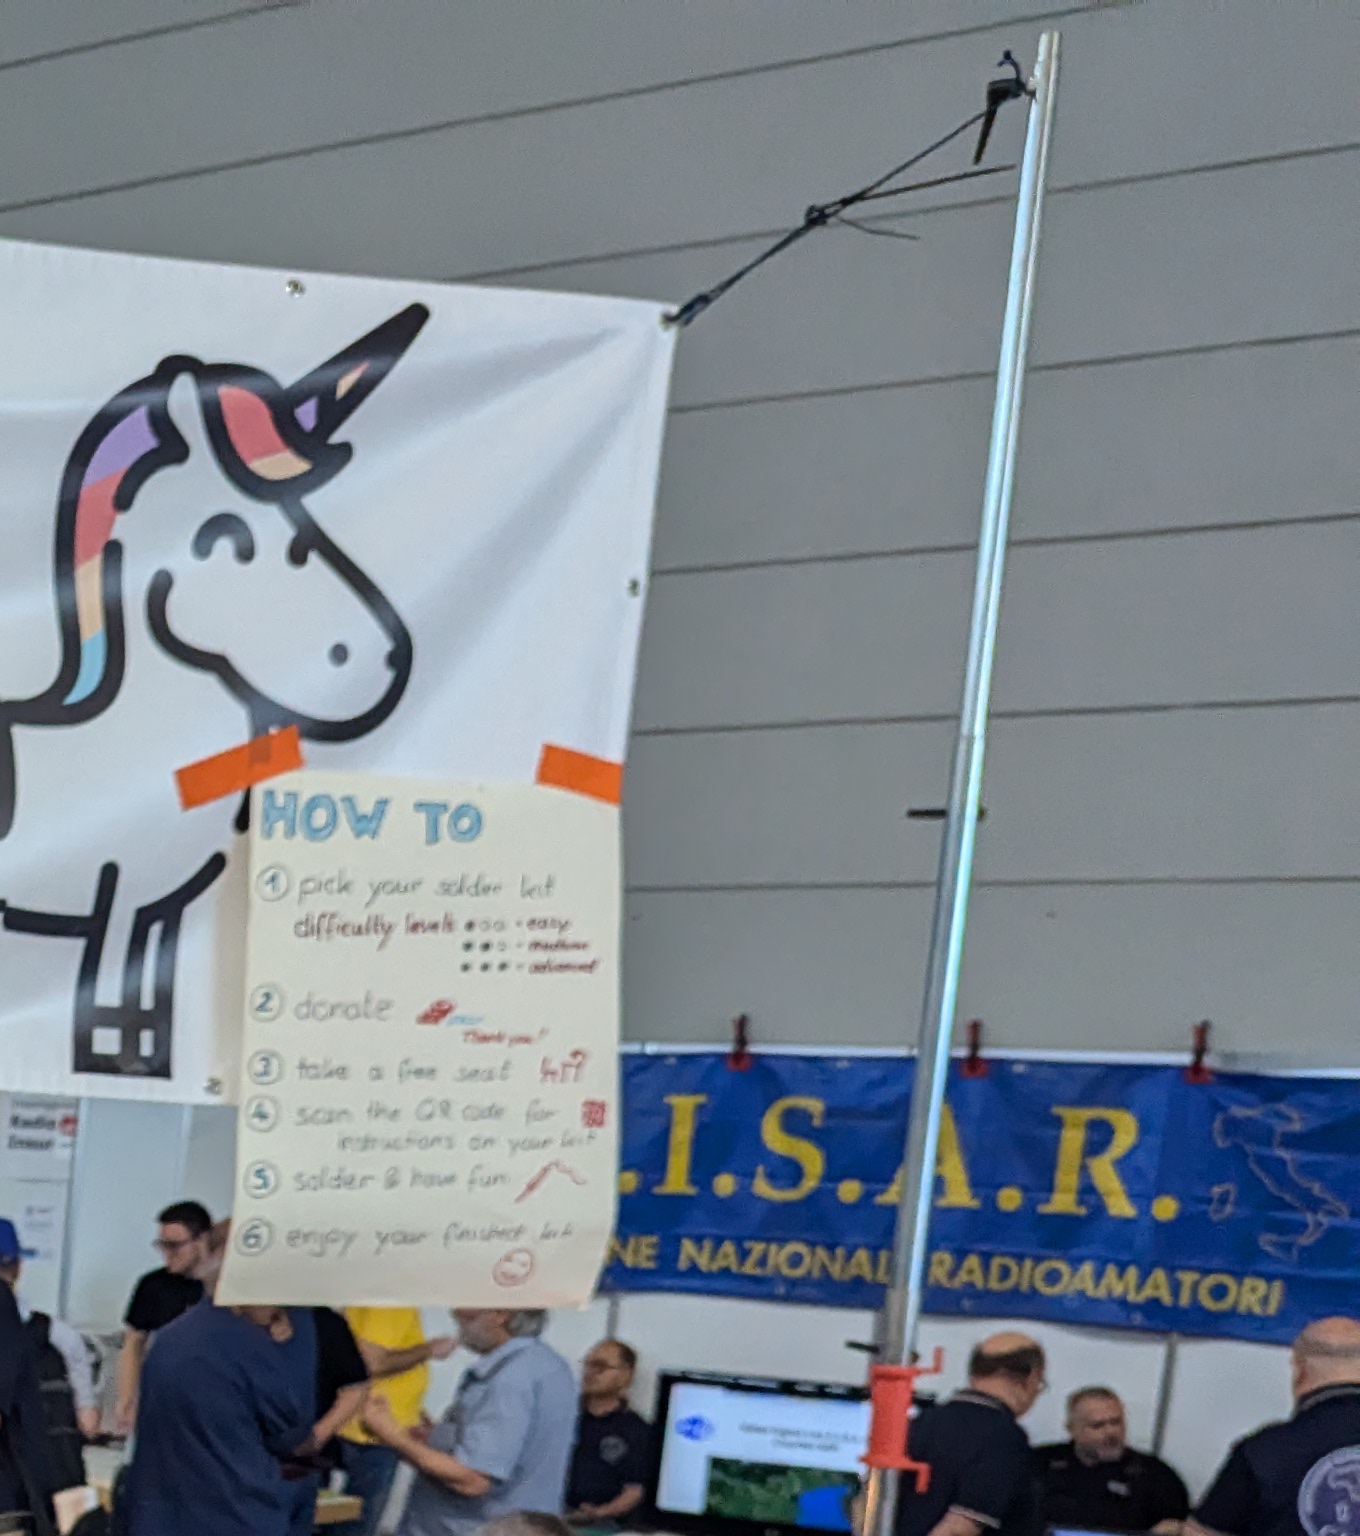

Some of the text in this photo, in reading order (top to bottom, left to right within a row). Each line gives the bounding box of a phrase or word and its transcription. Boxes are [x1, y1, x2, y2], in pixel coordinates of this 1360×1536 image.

[260, 789, 482, 845] HOW TO
[297, 870, 352, 905] pick
[367, 876, 421, 907] your
[434, 872, 503, 897] solder
[294, 912, 396, 952] difficulty
[526, 918, 572, 935] easy
[292, 989, 397, 1022] donate
[297, 1061, 349, 1081] take
[367, 1066, 383, 1081] a
[398, 1059, 437, 1082] free
[454, 1061, 511, 1082] seat
[294, 1105, 355, 1127] scan
[367, 1103, 400, 1122] the
[415, 1100, 451, 1122] QR
[462, 1103, 505, 1122] code
[524, 1100, 561, 1126] for
[337, 1132, 456, 1151] instructions
[468, 1135, 496, 1151] on
[508, 1136, 556, 1156] your
[292, 1167, 376, 1191] solder
[409, 1170, 457, 1188] have
[285, 1229, 359, 1257] enjoy
[374, 1232, 429, 1256] your
[442, 1223, 525, 1247] finished
[679, 1235, 894, 1284] NAZIONAL
[929, 1252, 1286, 1316] RADIOAMATORI
